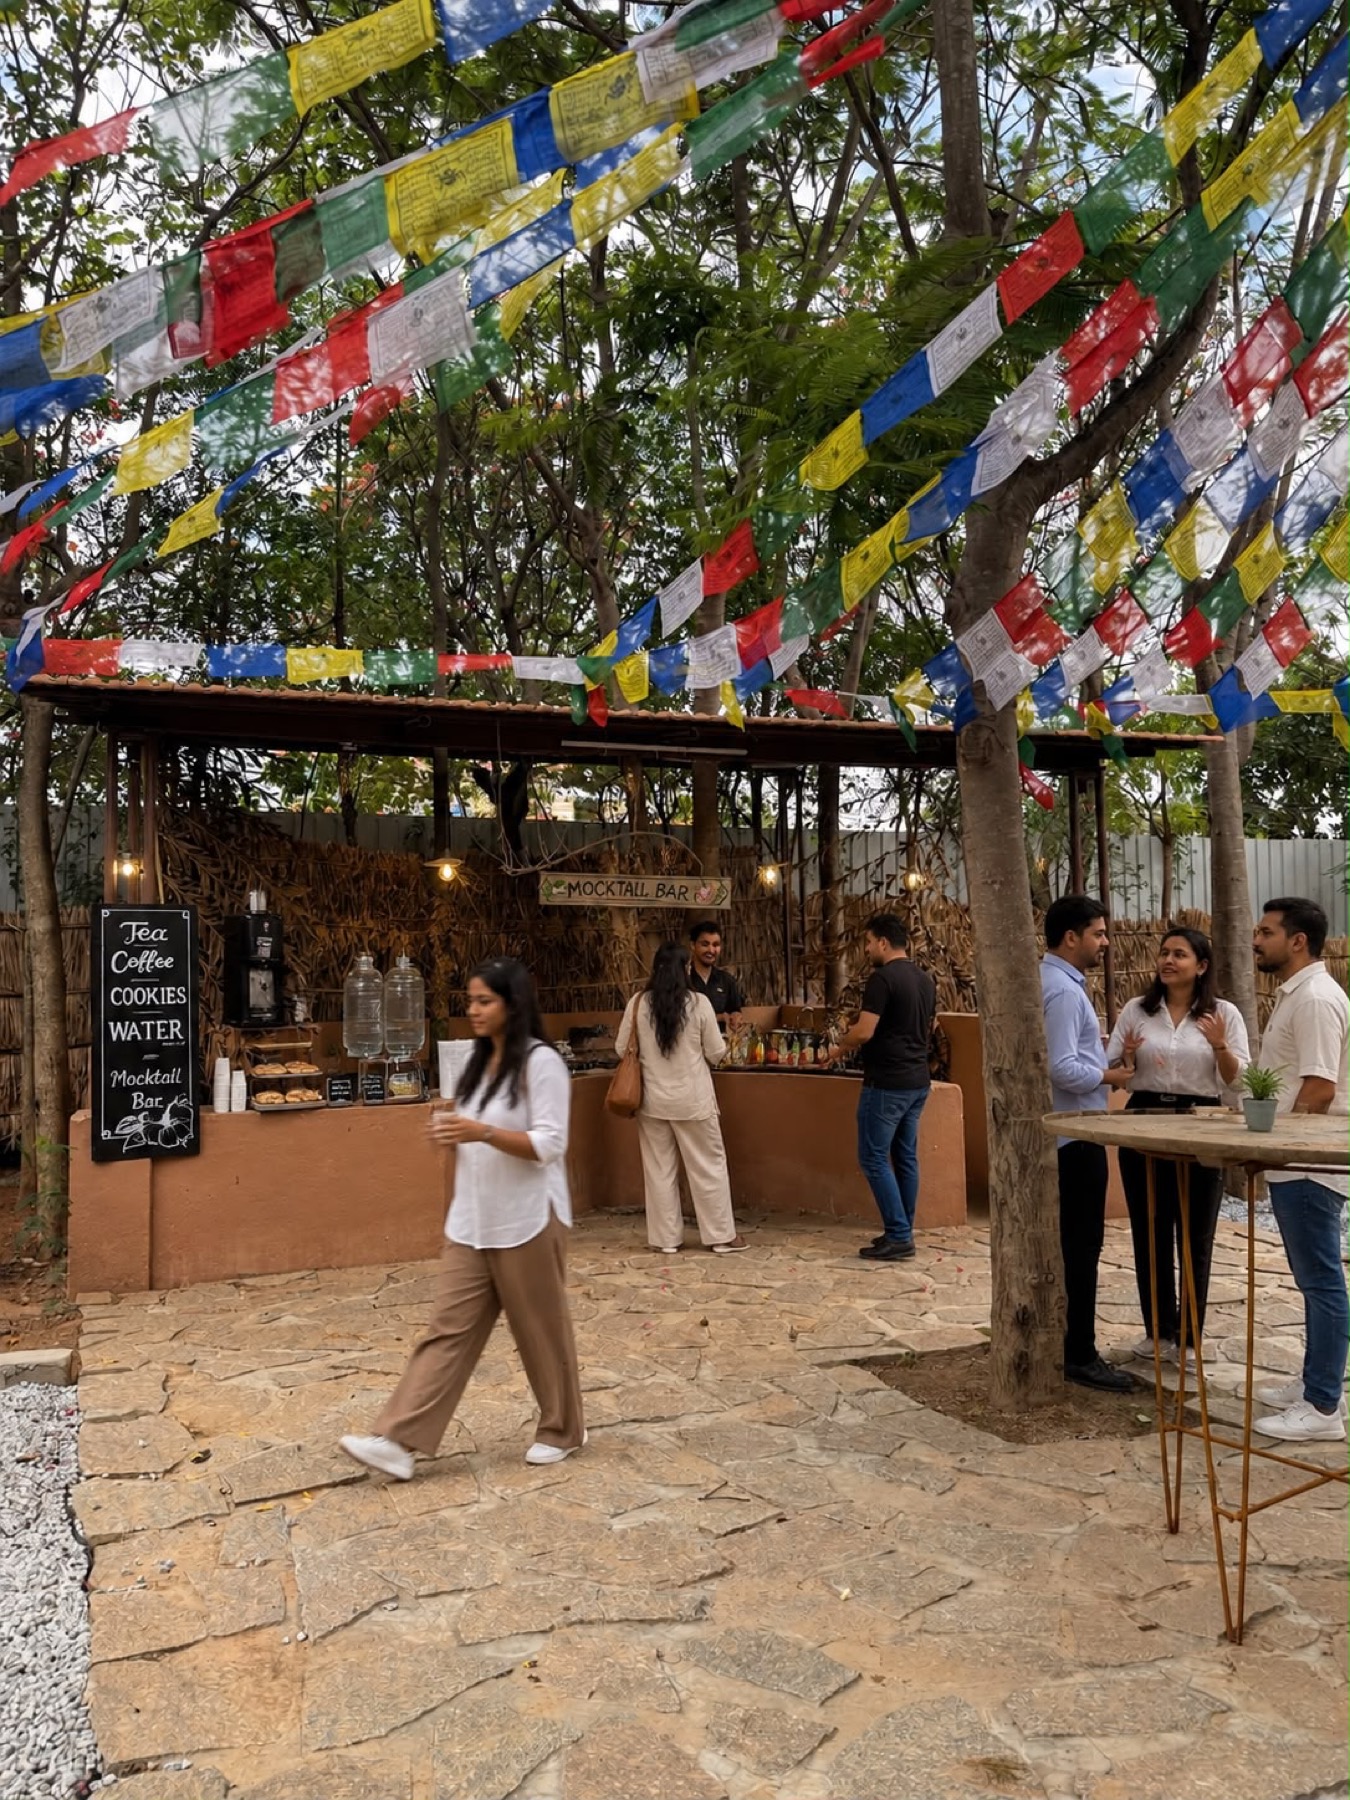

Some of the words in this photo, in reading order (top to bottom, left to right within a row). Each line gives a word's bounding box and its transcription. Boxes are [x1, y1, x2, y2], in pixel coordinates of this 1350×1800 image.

[656, 883, 689, 901] BAR
[119, 921, 168, 944] Tea
[111, 951, 174, 973] Coffee
[111, 986, 187, 1005] COOKIES
[109, 1019, 184, 1041] WATER
[110, 1068, 182, 1088] Mocktail
[131, 1092, 164, 1110] Bar
